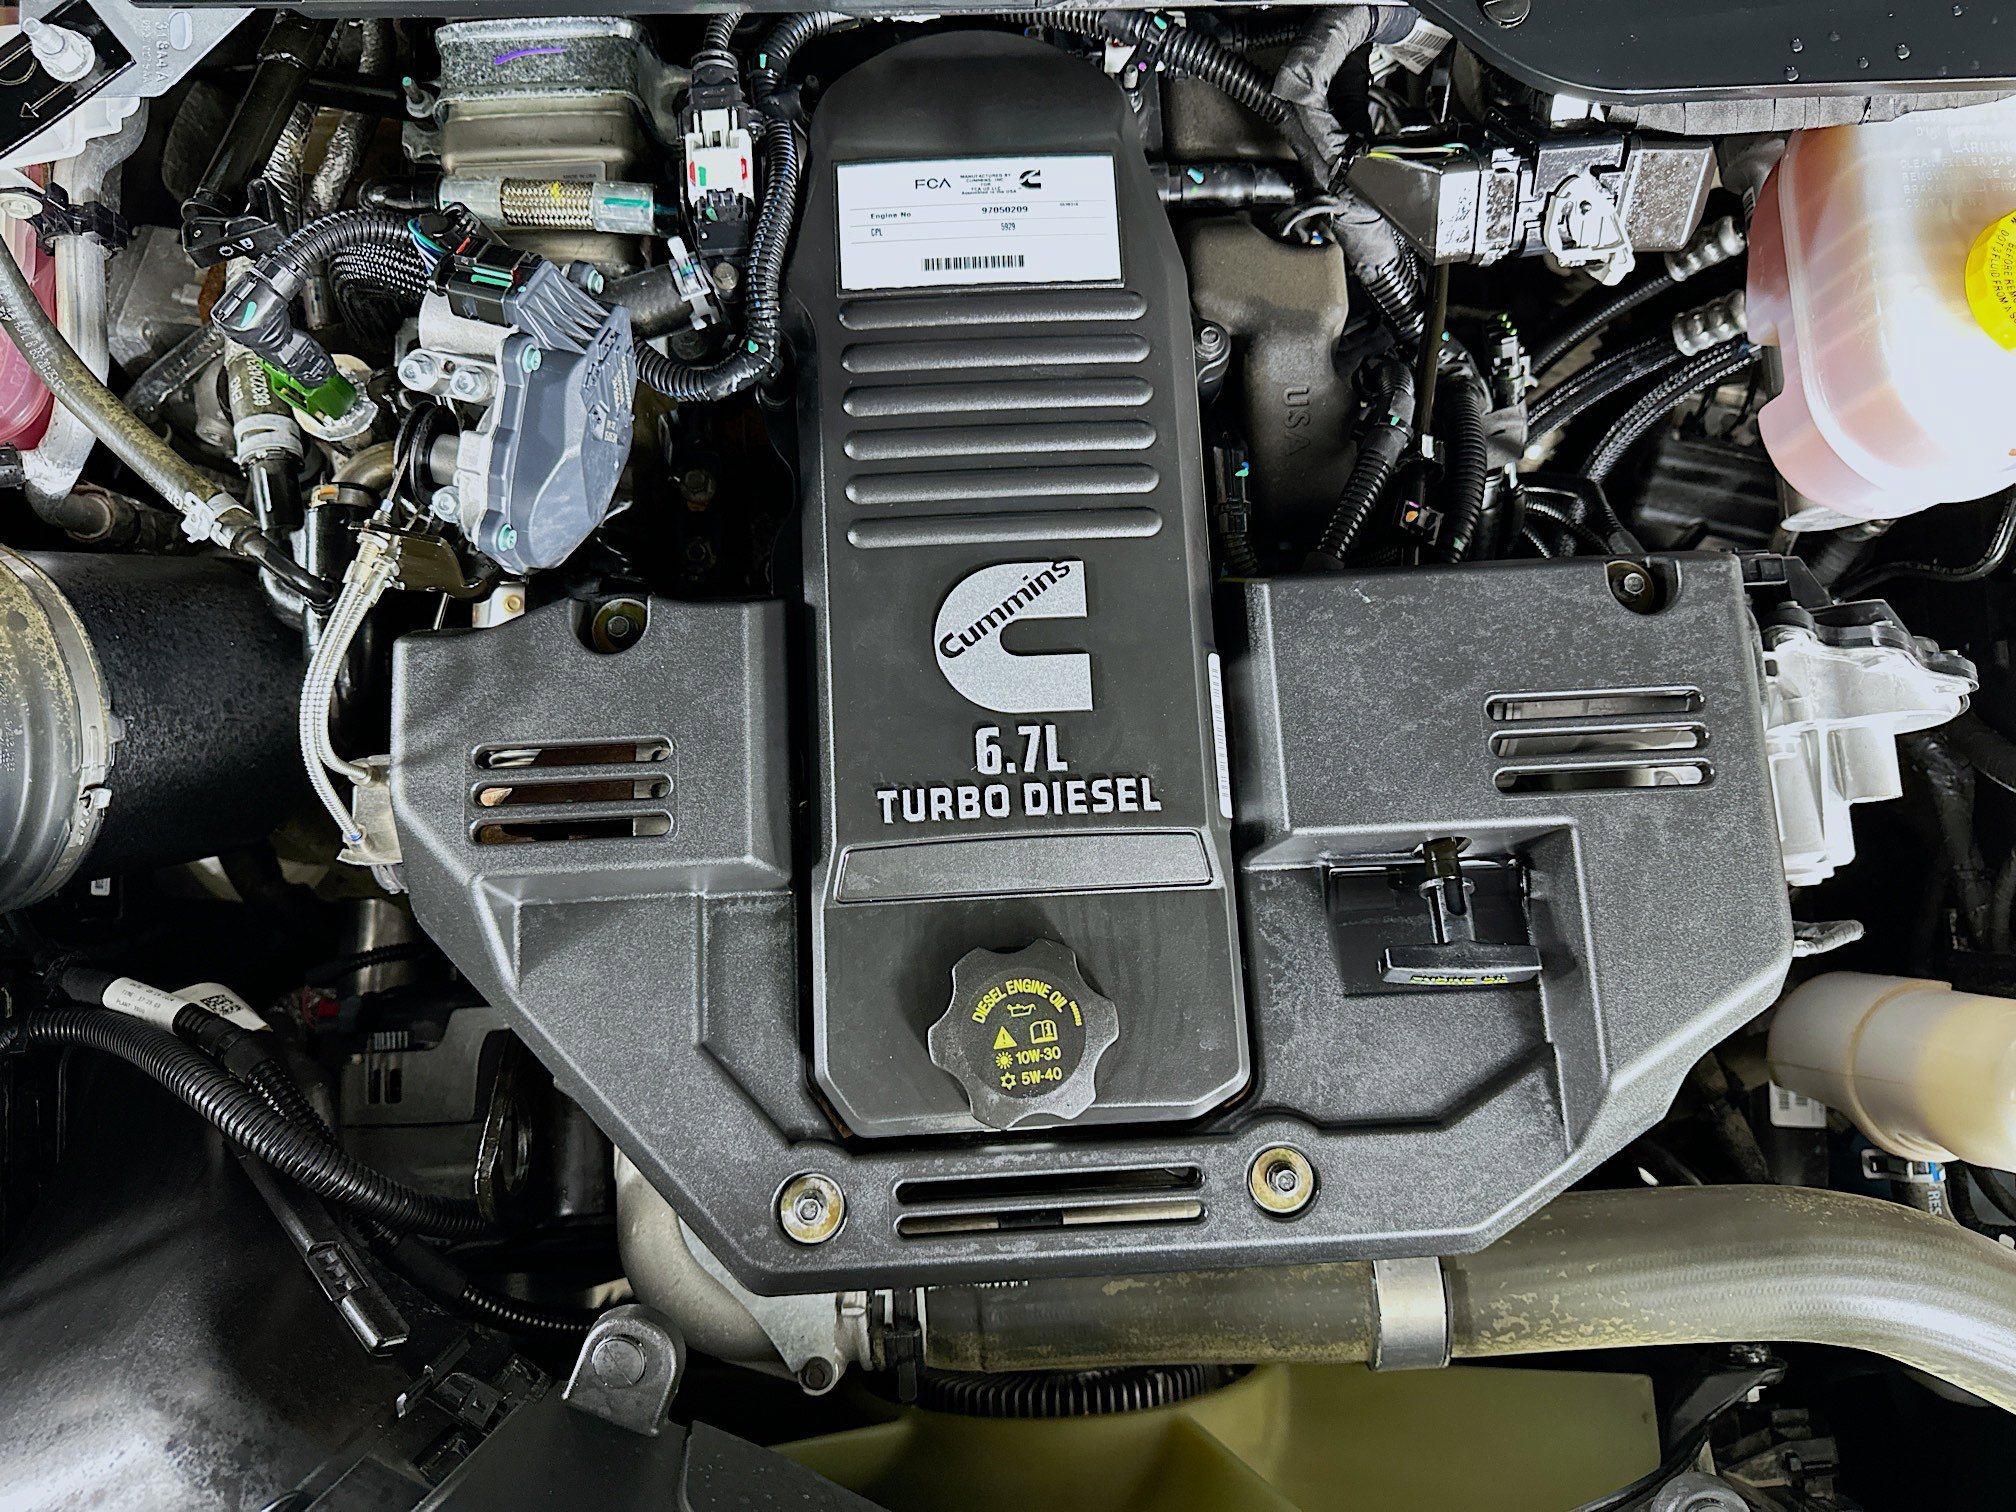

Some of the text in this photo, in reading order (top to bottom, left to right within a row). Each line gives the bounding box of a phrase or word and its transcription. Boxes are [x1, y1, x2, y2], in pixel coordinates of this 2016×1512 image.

[915, 178, 951, 189] FCA
[870, 212, 898, 220] Engine
[981, 206, 1028, 214] 97050209
[870, 228, 883, 237] CPL
[231, 375, 244, 405] ENG
[1283, 386, 1311, 456] USA
[939, 560, 1071, 658] Cummins
[975, 724, 1068, 776] 6.7L
[876, 777, 1162, 824] TURBO DIESEL
[972, 978, 1068, 1024] DIESEL ENGINE OIL
[1015, 1046, 1062, 1065] 10W-30
[1021, 1066, 1062, 1086] 5W-40
